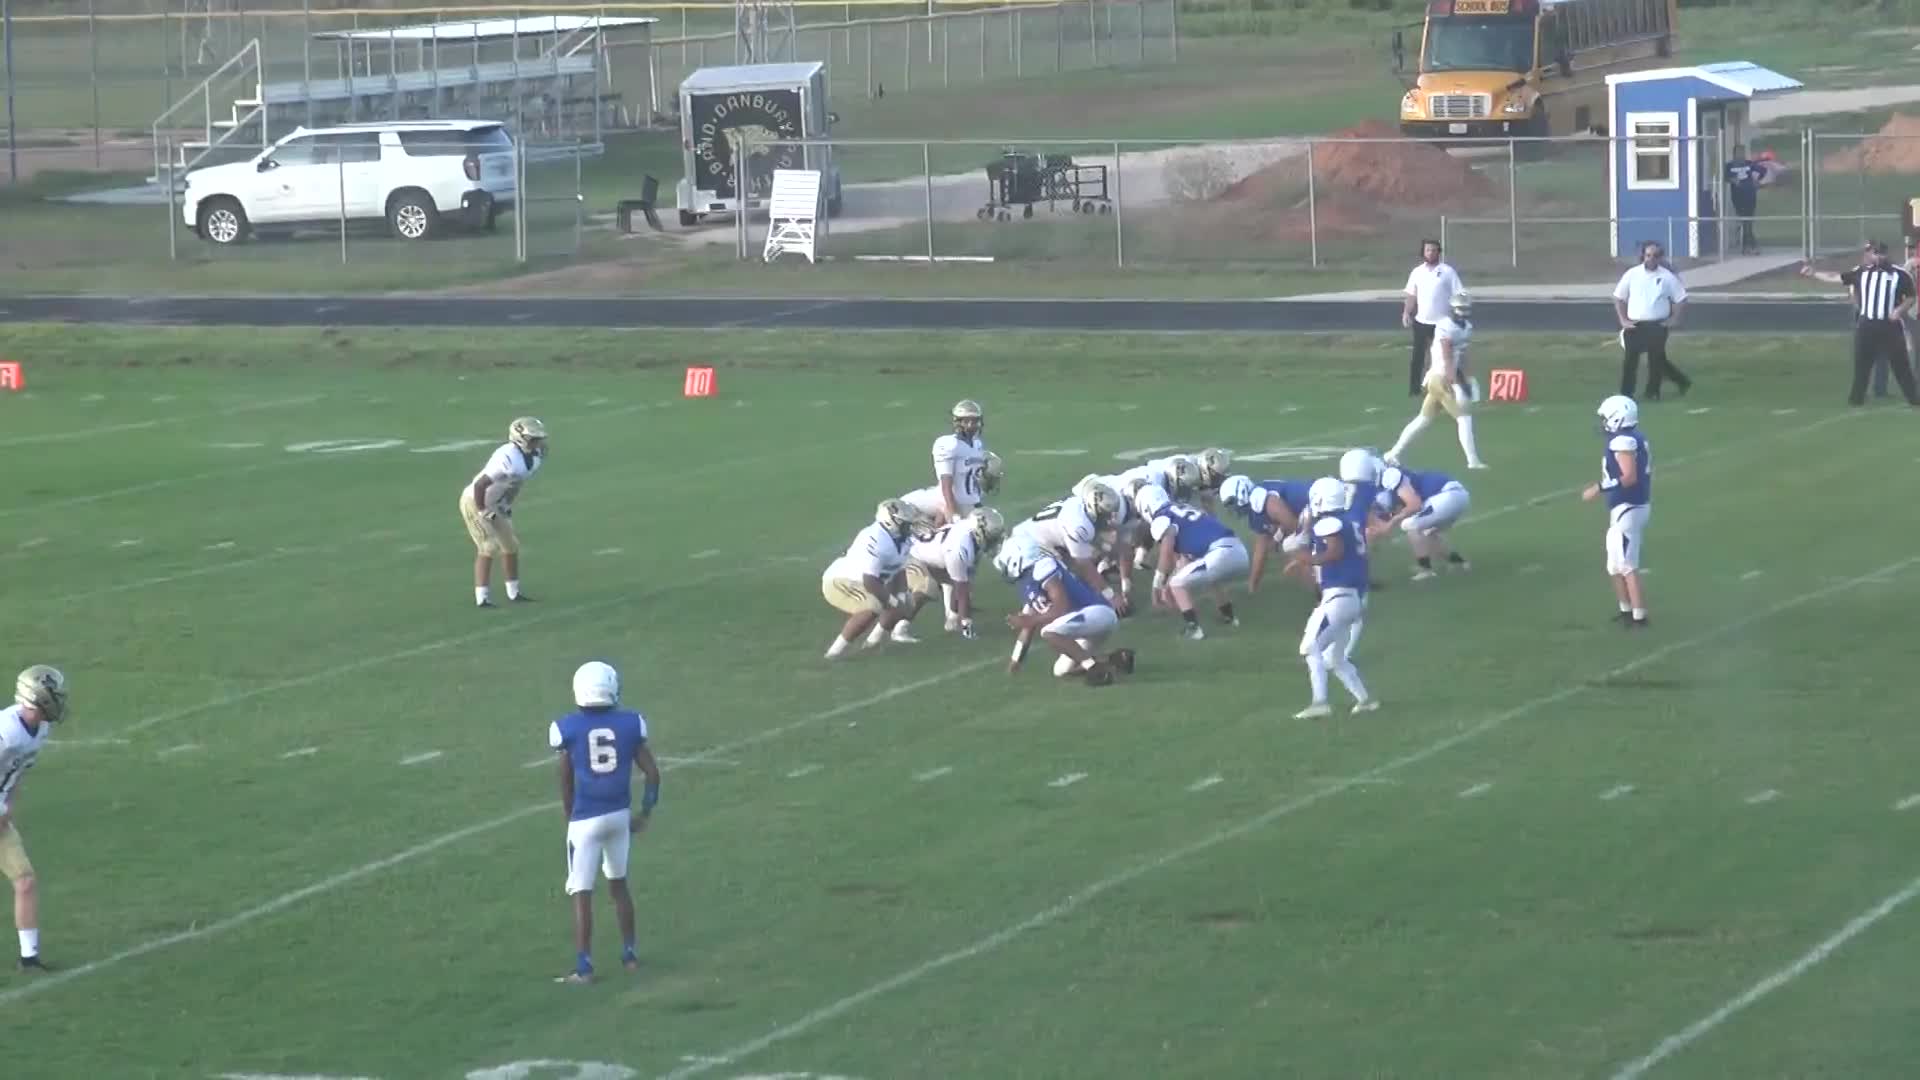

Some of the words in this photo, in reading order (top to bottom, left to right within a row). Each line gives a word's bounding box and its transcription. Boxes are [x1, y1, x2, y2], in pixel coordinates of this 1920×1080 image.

[1457, 0, 1486, 11] SCHOOL
[1490, 0, 1507, 11] BUS
[714, 94, 795, 132] DANBURY
[689, 371, 708, 395] 10
[1493, 373, 1520, 401] 20
[587, 728, 618, 774] 6
